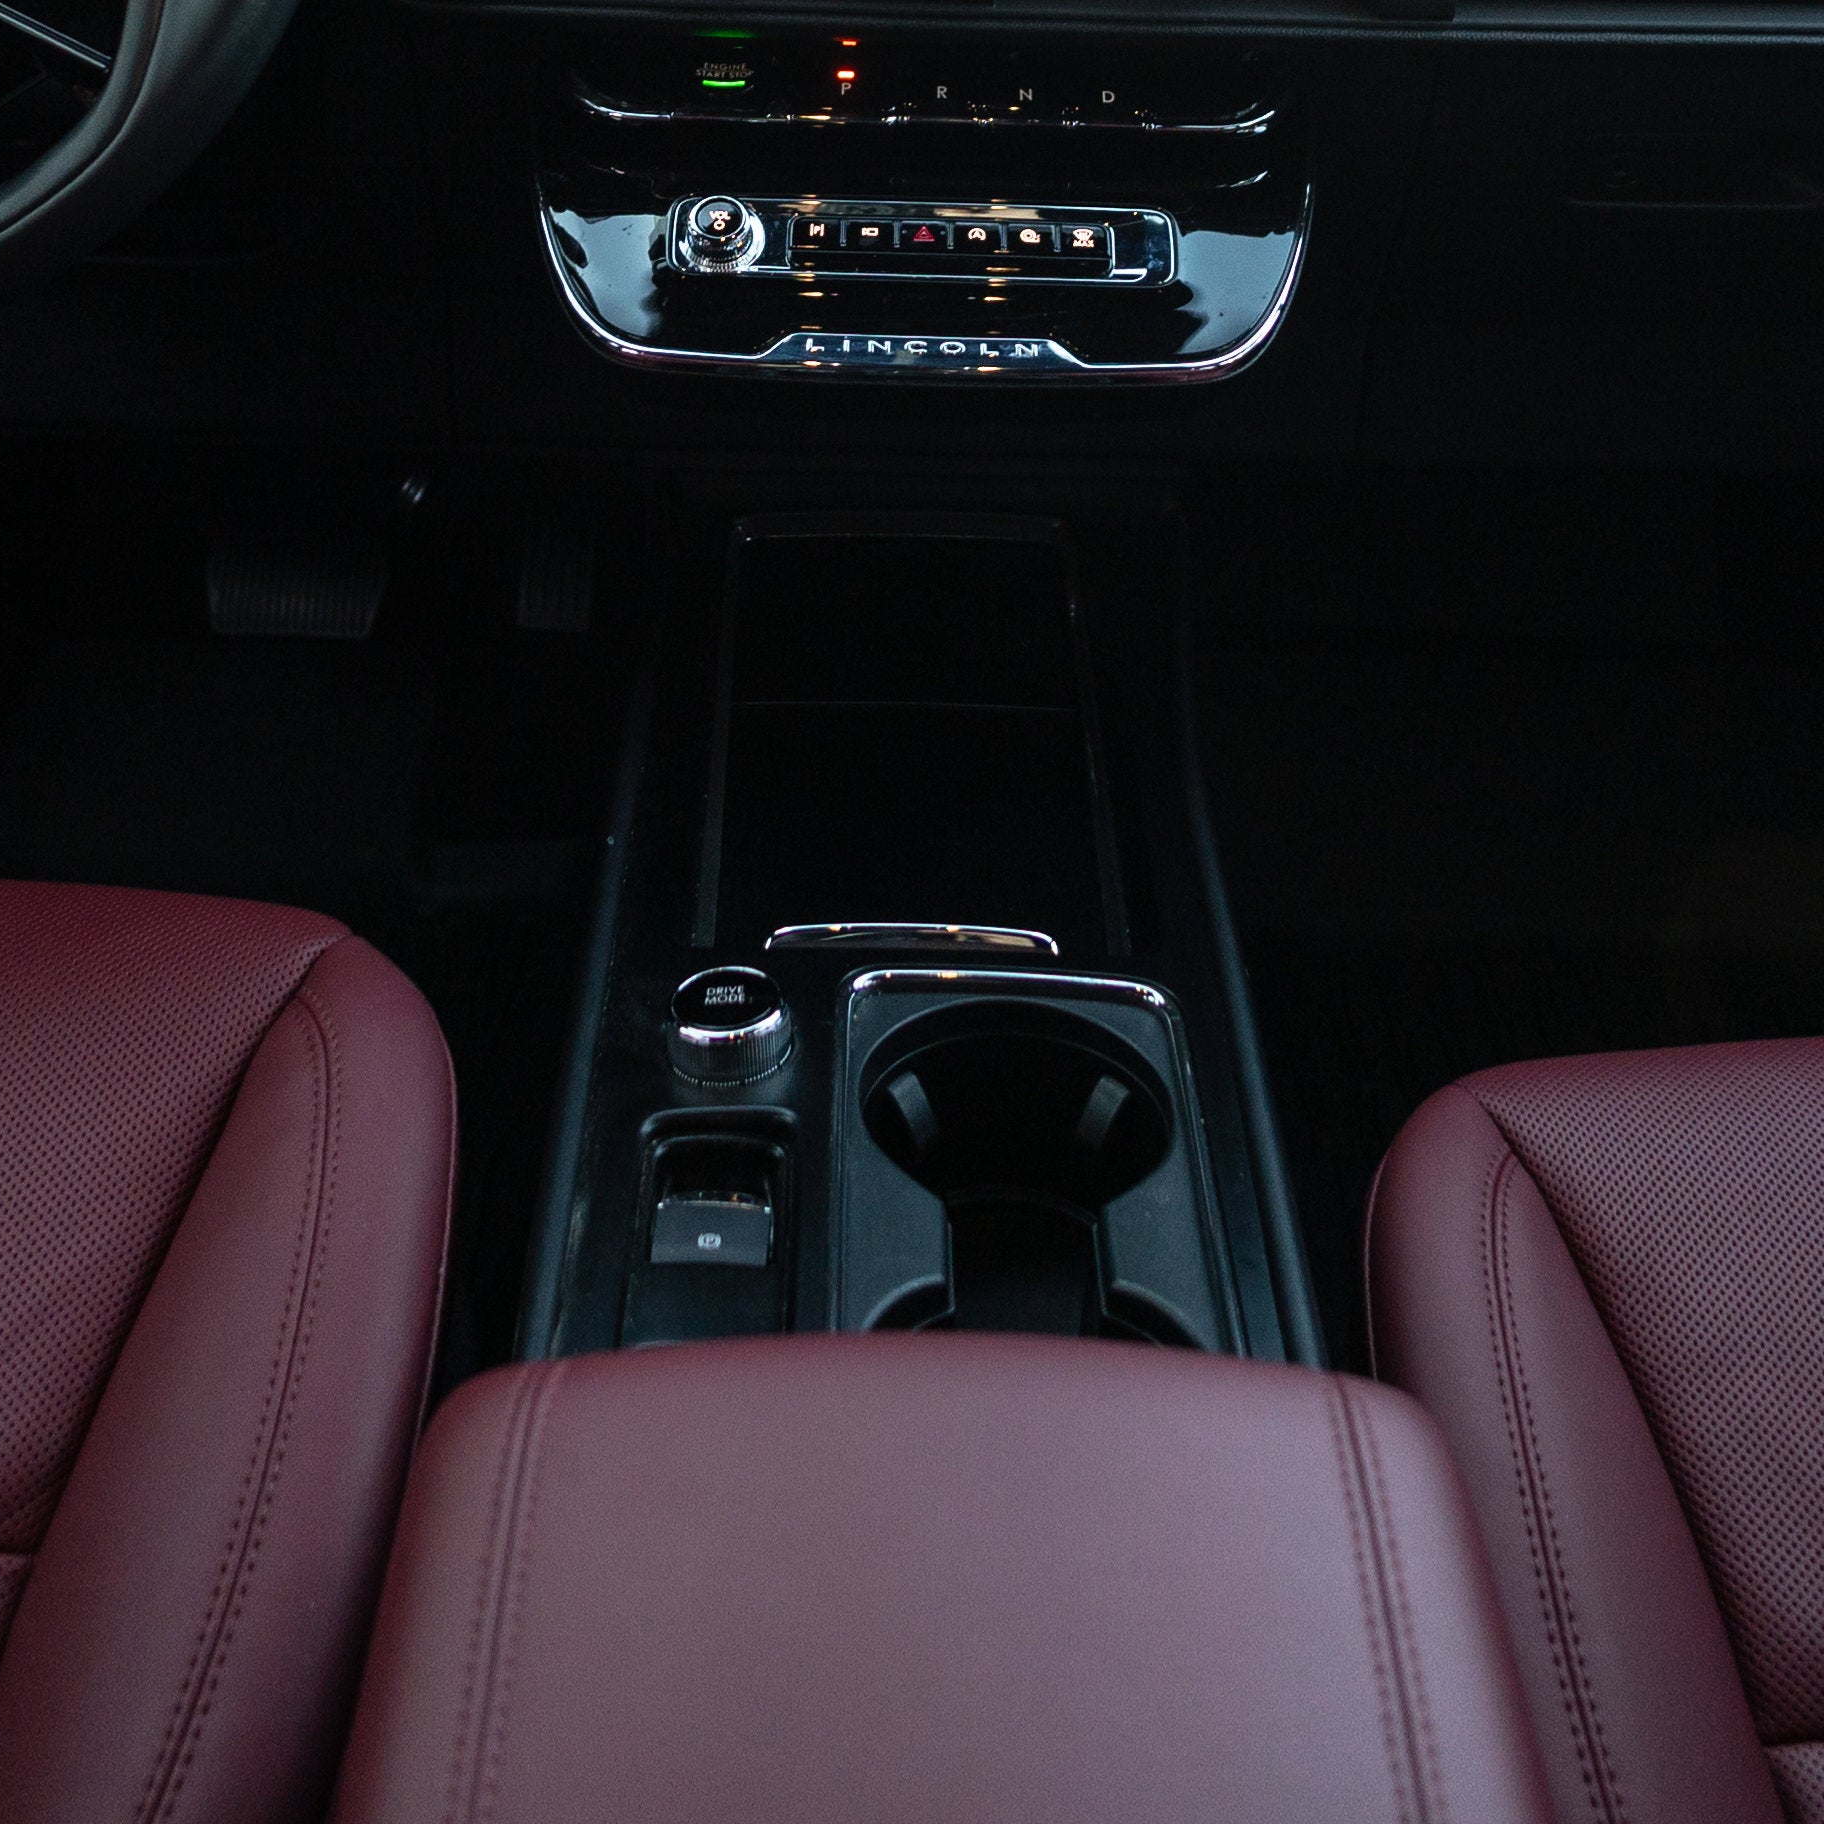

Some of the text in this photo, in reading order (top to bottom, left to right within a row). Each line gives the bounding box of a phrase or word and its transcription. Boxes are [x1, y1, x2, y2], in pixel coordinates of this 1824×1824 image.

[703, 61, 748, 71] ENGINE
[695, 69, 755, 79] START STOP
[840, 82, 1115, 103] P R N D
[708, 210, 731, 222] VOL
[1072, 239, 1095, 248] MAX
[805, 337, 1039, 357] LINCOLN
[706, 985, 744, 996] DRIVE
[704, 994, 745, 1006] MODE
